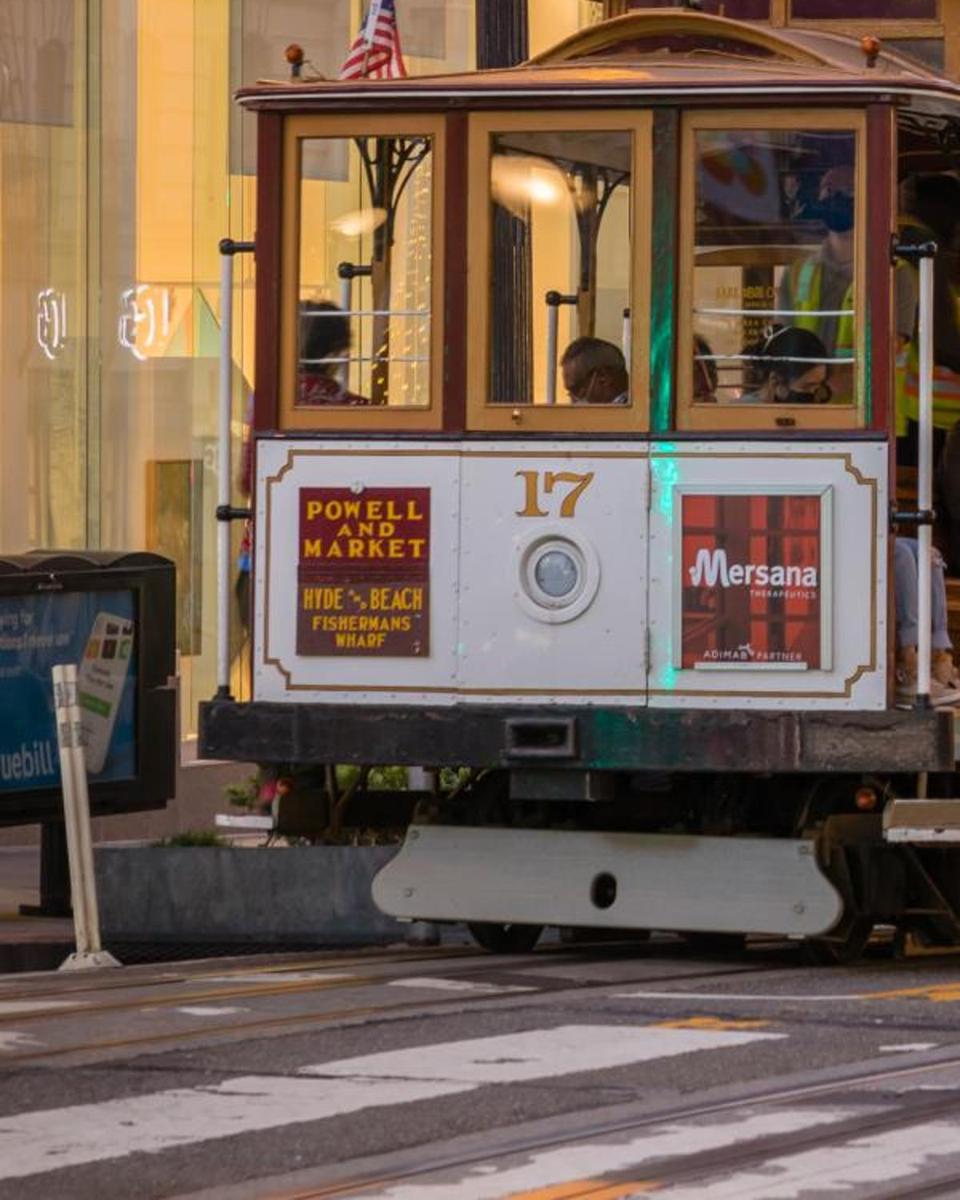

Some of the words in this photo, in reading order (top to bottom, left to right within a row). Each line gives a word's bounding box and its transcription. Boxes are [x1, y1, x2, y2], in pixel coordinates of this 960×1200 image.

[515, 470, 594, 517] 17
[306, 500, 423, 521] POWELL
[336, 521, 396, 538] AND
[303, 538, 426, 559] MARKET
[689, 549, 817, 588] Mersana
[303, 588, 344, 610] HYDE
[370, 587, 423, 611] BEACH
[312, 616, 412, 631] FISHERMANS
[336, 633, 386, 647] WHARF
[704, 650, 748, 660] ADIMAB
